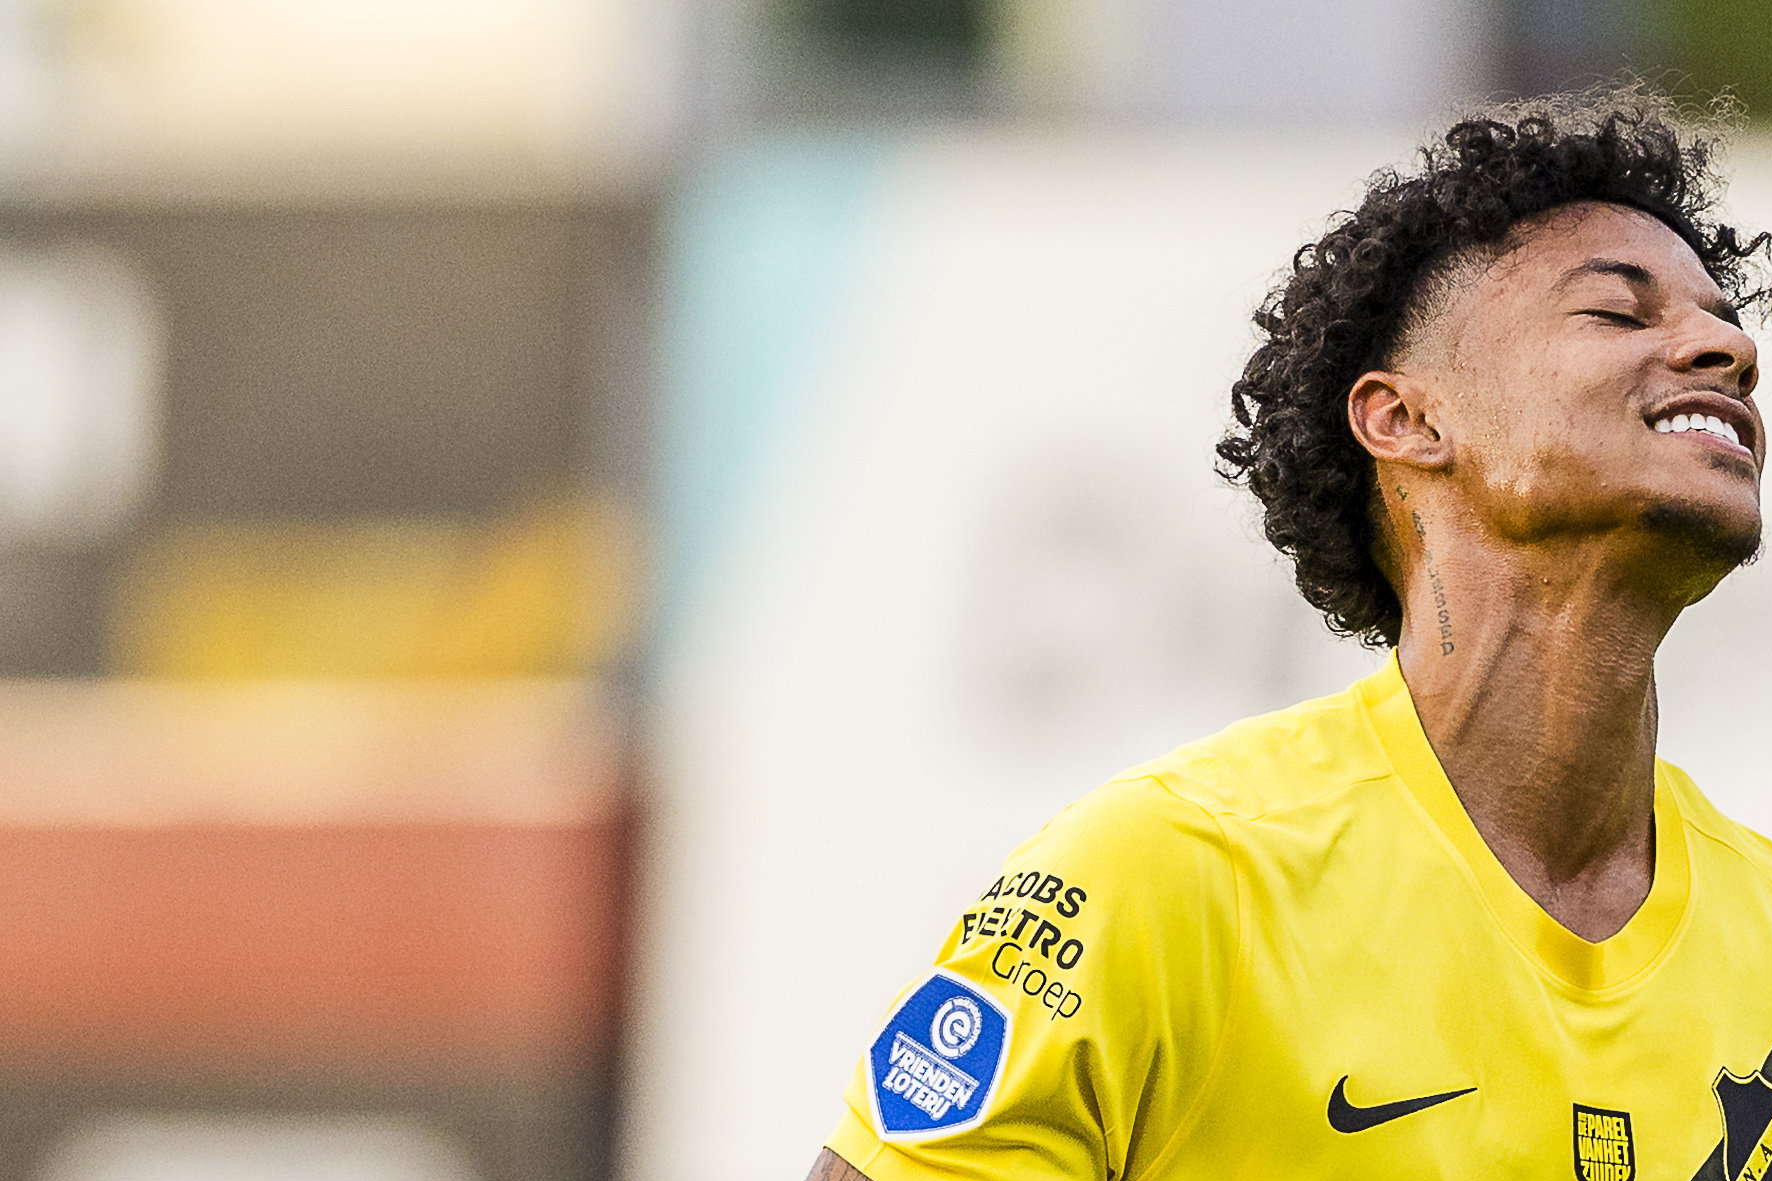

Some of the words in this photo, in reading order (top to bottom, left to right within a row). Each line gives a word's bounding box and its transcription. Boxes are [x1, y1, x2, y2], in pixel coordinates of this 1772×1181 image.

[980, 871, 1087, 918] ACOBS
[992, 942, 1082, 1020] Groep
[882, 1066, 952, 1121] LOTERIJ
[888, 1040, 974, 1110] VRIENDEN
[1587, 1113, 1628, 1141] PAREL
